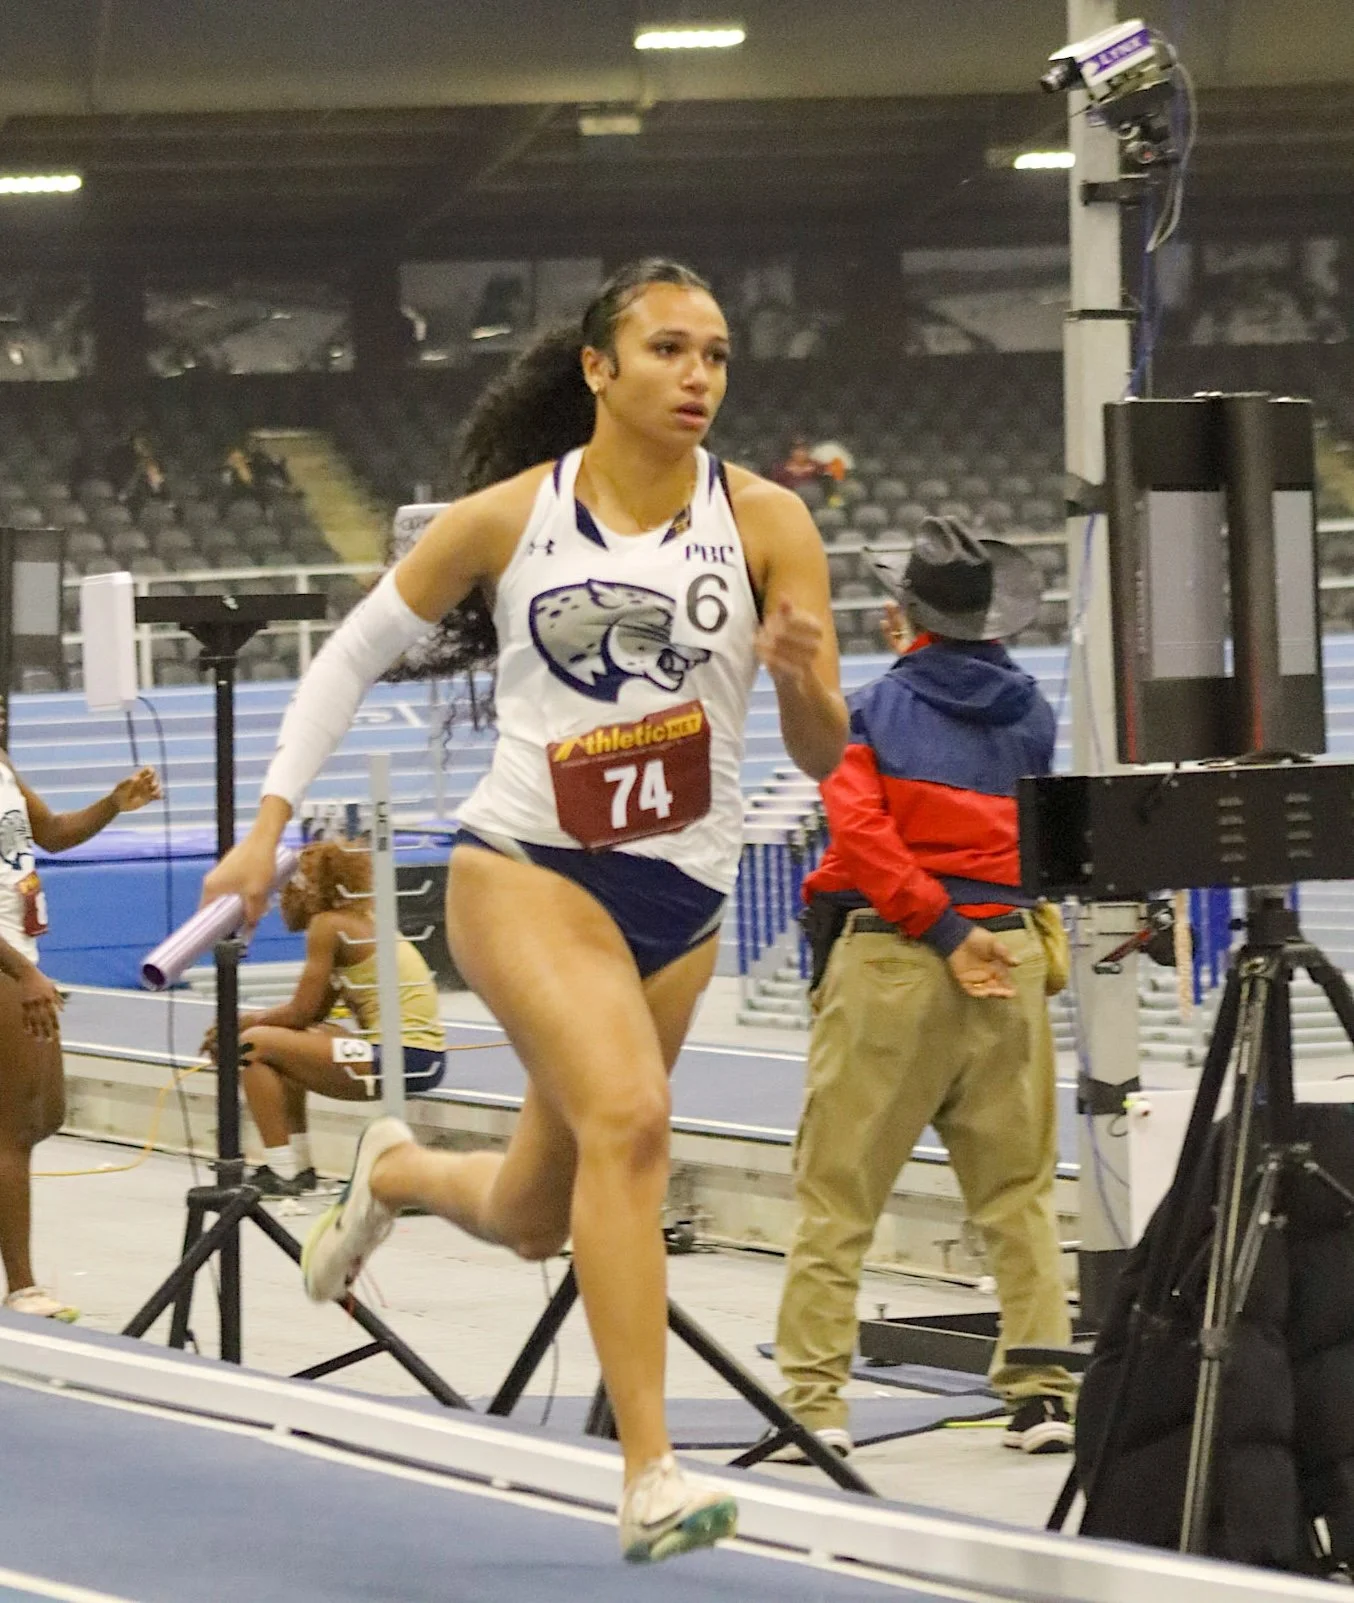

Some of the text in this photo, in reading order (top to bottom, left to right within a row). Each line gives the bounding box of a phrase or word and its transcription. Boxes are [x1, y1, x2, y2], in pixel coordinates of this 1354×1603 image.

[1096, 35, 1143, 67] LYNX
[685, 544, 737, 567] PBC
[686, 573, 729, 634] 6
[603, 758, 673, 829] 74
